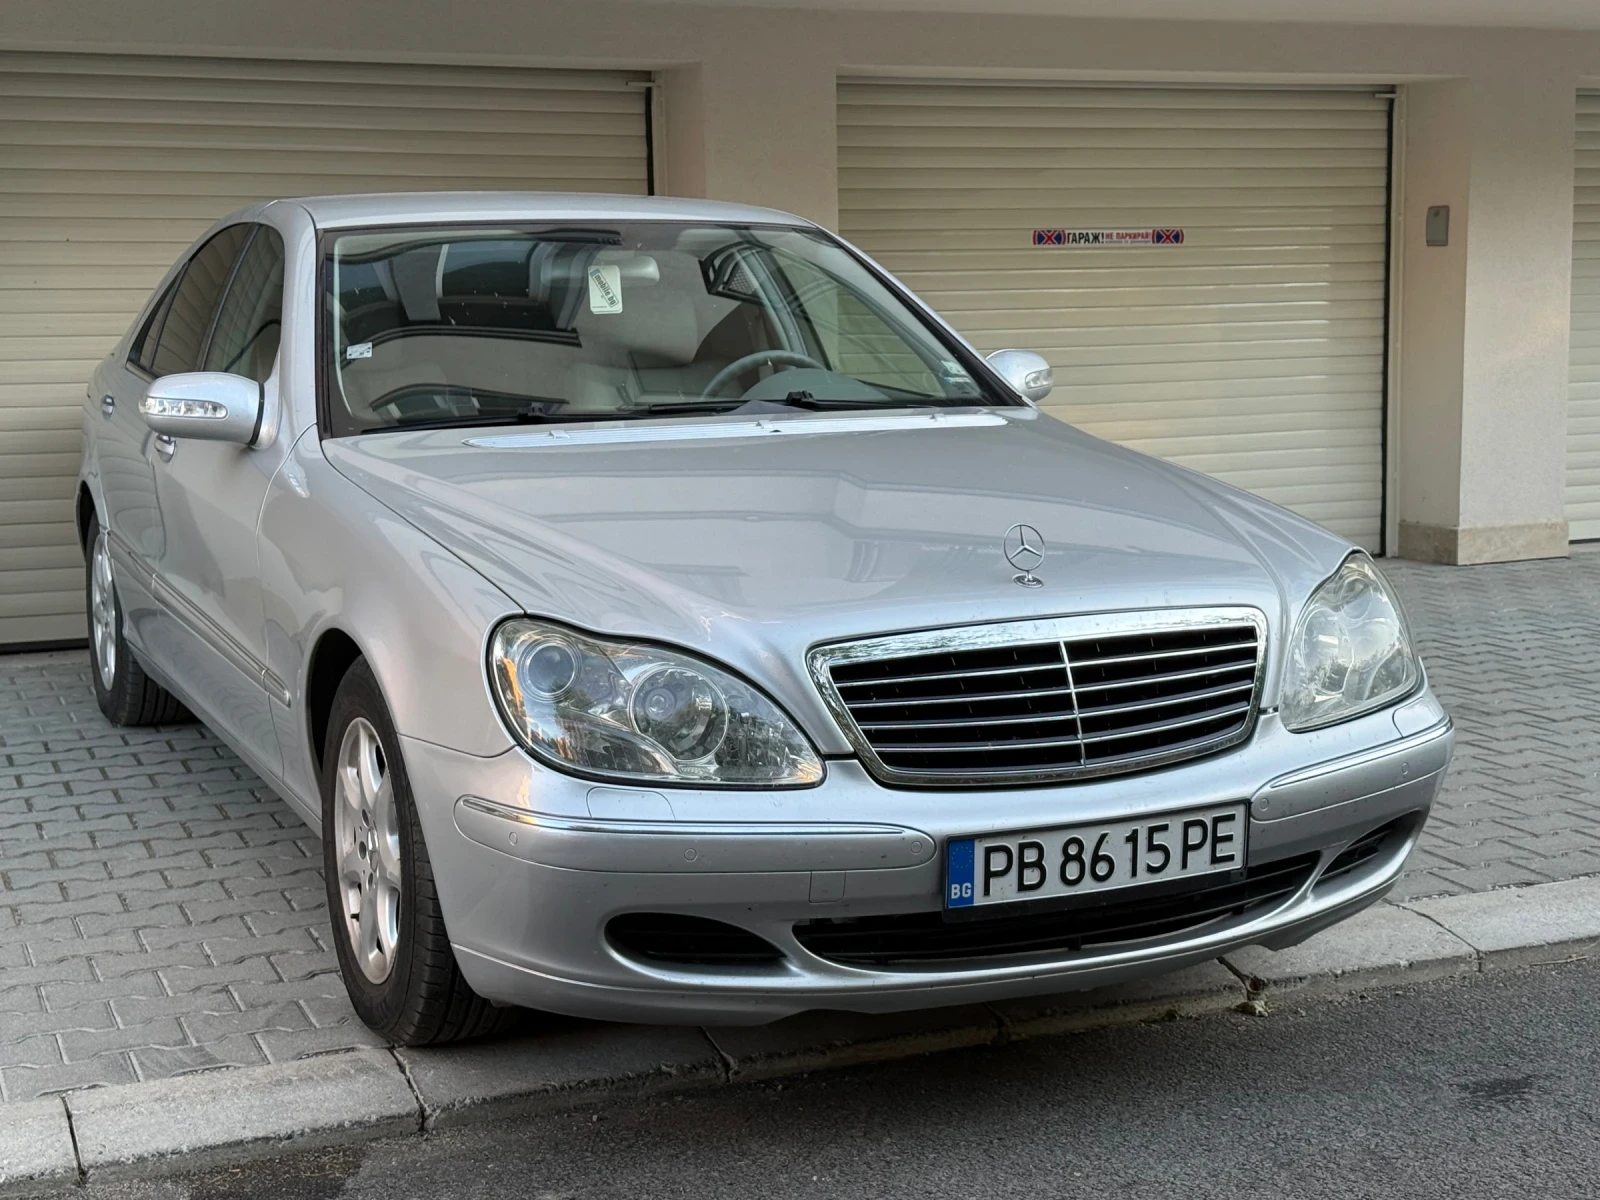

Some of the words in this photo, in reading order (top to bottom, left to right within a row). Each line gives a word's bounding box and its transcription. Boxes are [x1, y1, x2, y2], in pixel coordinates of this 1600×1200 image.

[1067, 232, 1105, 245] ГАРАЖ!
[983, 840, 1046, 897] PB
[1059, 823, 1172, 886] 8615
[1181, 813, 1237, 870] PE
[950, 882, 972, 899] BG
